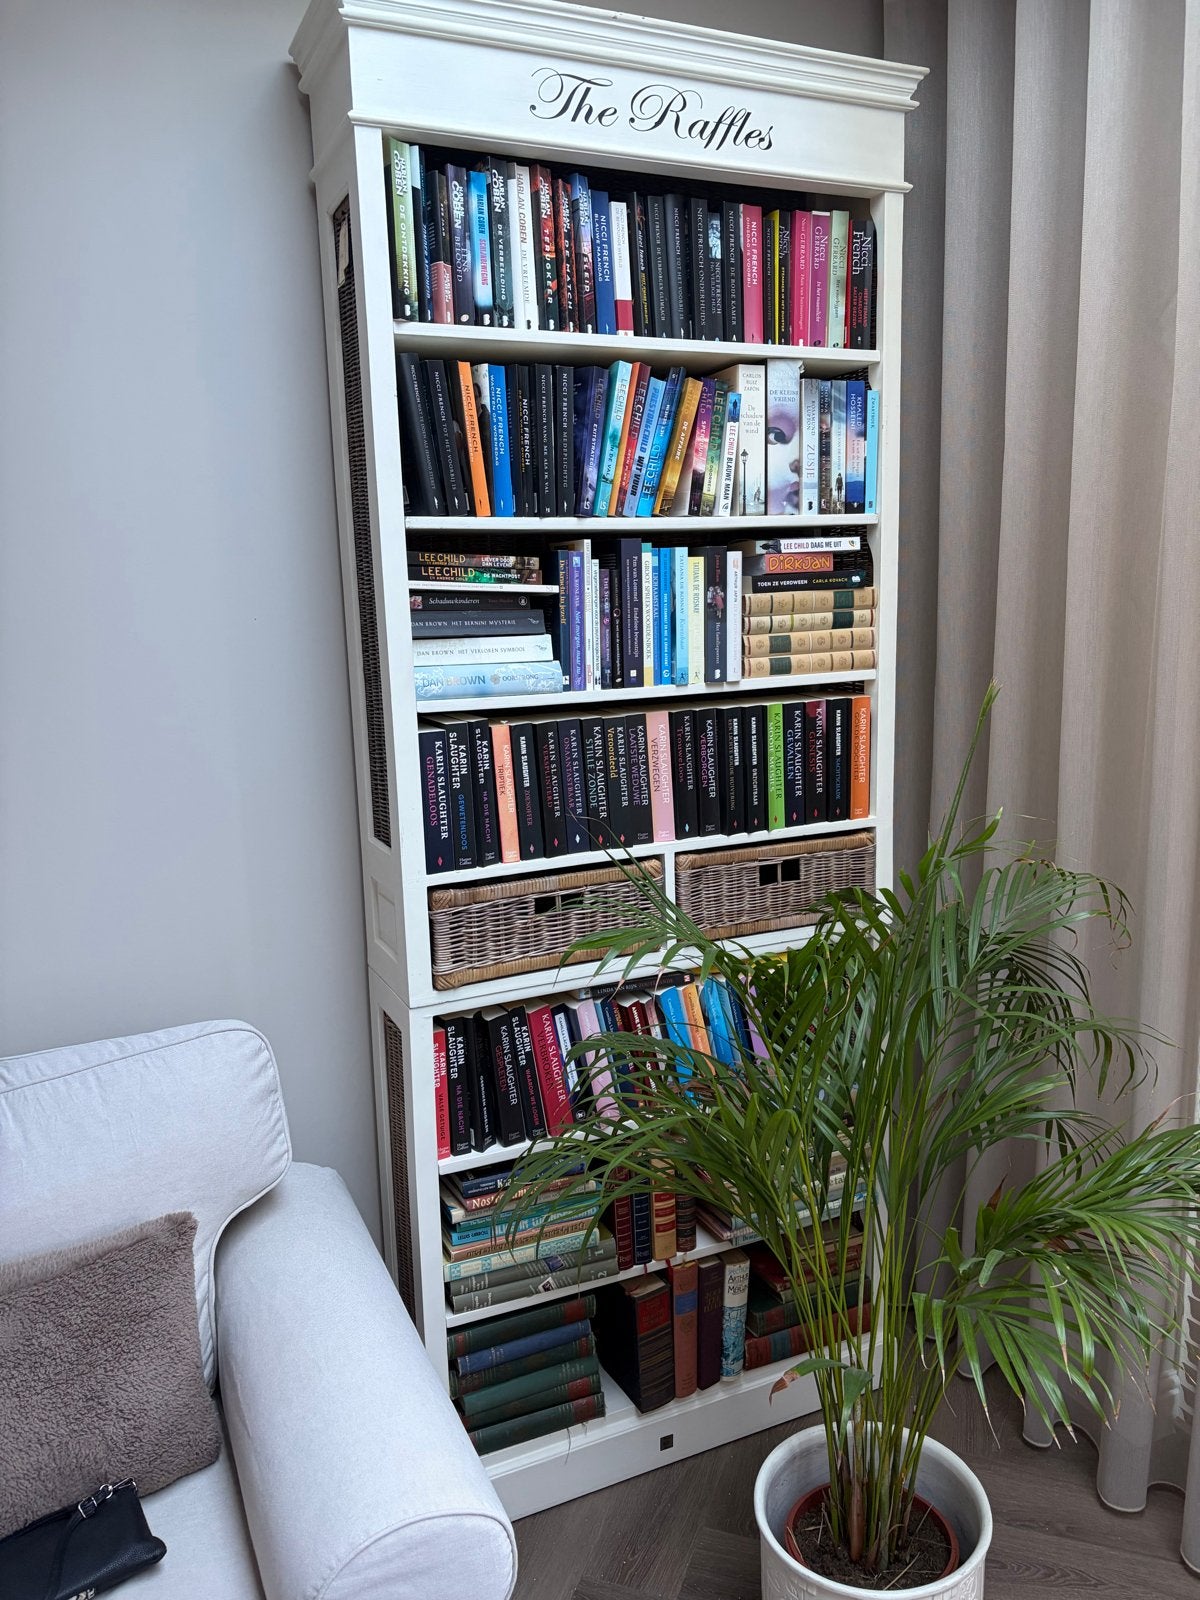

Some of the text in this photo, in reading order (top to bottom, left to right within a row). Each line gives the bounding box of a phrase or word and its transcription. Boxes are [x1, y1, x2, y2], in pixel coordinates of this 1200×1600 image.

[530, 68, 774, 150] The Raffles
[393, 150, 404, 196] COBEN
[398, 157, 408, 192] HARLAN
[492, 169, 501, 212] COBEN
[452, 180, 462, 230] COBEN
[398, 204, 410, 296] DE ONTDEKKING
[454, 236, 463, 282] BELOOFD
[544, 229, 553, 304] TERUGKEER
[814, 226, 823, 270] GERRARD
[832, 237, 840, 276] GERRARD
[852, 230, 863, 275] French
[861, 236, 872, 267] Nicci
[464, 384, 478, 453] NICCI FRENCH
[630, 380, 648, 440] LEE CHILD
[630, 387, 660, 496] PRESTON&CHILD WIT VUUR
[674, 421, 689, 461] DE AFFAIRE
[727, 438, 735, 456] CHILD
[806, 444, 816, 479] ZUSJE
[640, 444, 662, 501] LEE CHILD
[723, 482, 732, 500] MAAN
[724, 457, 734, 482] BLAUWE
[419, 554, 466, 562] LEE CHILD
[422, 567, 475, 577] LEE CHILD
[559, 560, 566, 569] De
[559, 604, 567, 624] jezelf
[422, 678, 444, 687] DAN
[446, 676, 486, 686] BROWN
[449, 732, 460, 788] SLAUGHTER
[459, 744, 468, 774] KARIN
[475, 728, 484, 784] SLAUGHTER
[482, 740, 490, 770] KARIN
[503, 744, 514, 813] KARIN SLAUGHTER
[521, 755, 530, 788] SLAUGHTER
[548, 731, 560, 818] KARIN SLAUGHTER
[564, 737, 574, 808] ONAANTASTBAAR
[570, 729, 582, 814] KARIN SLAUGHTER
[585, 738, 598, 808] STILLE ZONDE
[593, 726, 608, 819] KARIN SLAUGHTER
[607, 727, 618, 778] Veroordeeld
[616, 726, 629, 807] KARIN SLAUGHTER
[629, 727, 640, 806] LAATSTE WEDUWE
[637, 725, 649, 806] KARIN SLAUGHTER
[651, 738, 660, 792] VERZWEGEN
[659, 724, 670, 804] KARIN SLAUGHTER
[686, 742, 694, 790] SLAUGHTER
[700, 732, 708, 788] VERBORGEN
[706, 719, 716, 798] KARIN SLAUGHTER
[774, 744, 782, 800] SLAUGHTER
[426, 756, 438, 826] GENADELOOS
[435, 740, 449, 840] KARIN SLAUGHTER
[497, 764, 506, 796] TRIPTIEK
[458, 794, 468, 850] GEWETENLOOS
[447, 1025, 458, 1079] SLAUGHTER
[456, 1036, 465, 1065] KARIN
[511, 1016, 527, 1066] SLAUGHTER
[521, 1025, 532, 1052] KARIN
[536, 1031, 554, 1090] VERBROKEN
[542, 1013, 567, 1102] KARIN SLAUGHTER
[456, 1084, 462, 1095] NA
[495, 1044, 507, 1092] GESPLETEN
[500, 1025, 518, 1106] KARIN SLAUGHTER
